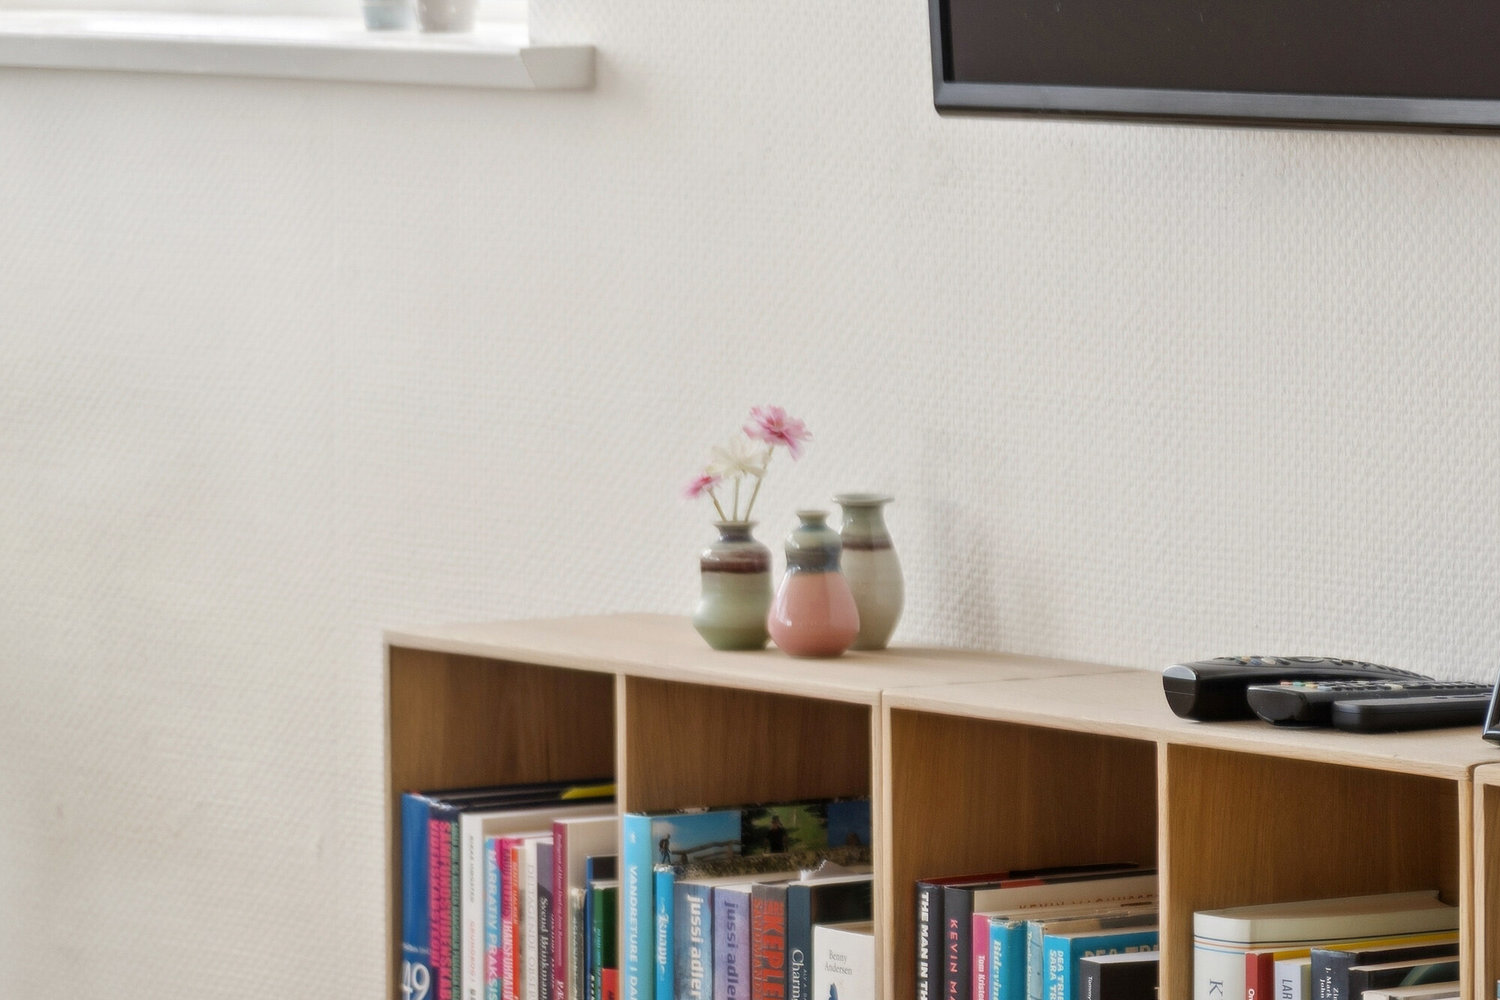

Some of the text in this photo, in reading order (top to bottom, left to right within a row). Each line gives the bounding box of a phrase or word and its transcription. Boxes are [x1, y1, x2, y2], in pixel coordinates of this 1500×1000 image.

[488, 849, 498, 929] NARRATIV
[920, 892, 929, 921] THE
[540, 897, 549, 932] Svend
[629, 866, 638, 963] VANDRETURE
[687, 895, 704, 943] jussi
[725, 900, 739, 948] jussi
[828, 950, 849, 963] Benny
[920, 924, 929, 959] MAN
[949, 919, 958, 974] KEVIN
[825, 961, 853, 976] Andersen
[920, 962, 929, 978] IN
[977, 955, 985, 972] Tom
[1049, 949, 1057, 980] SARA
